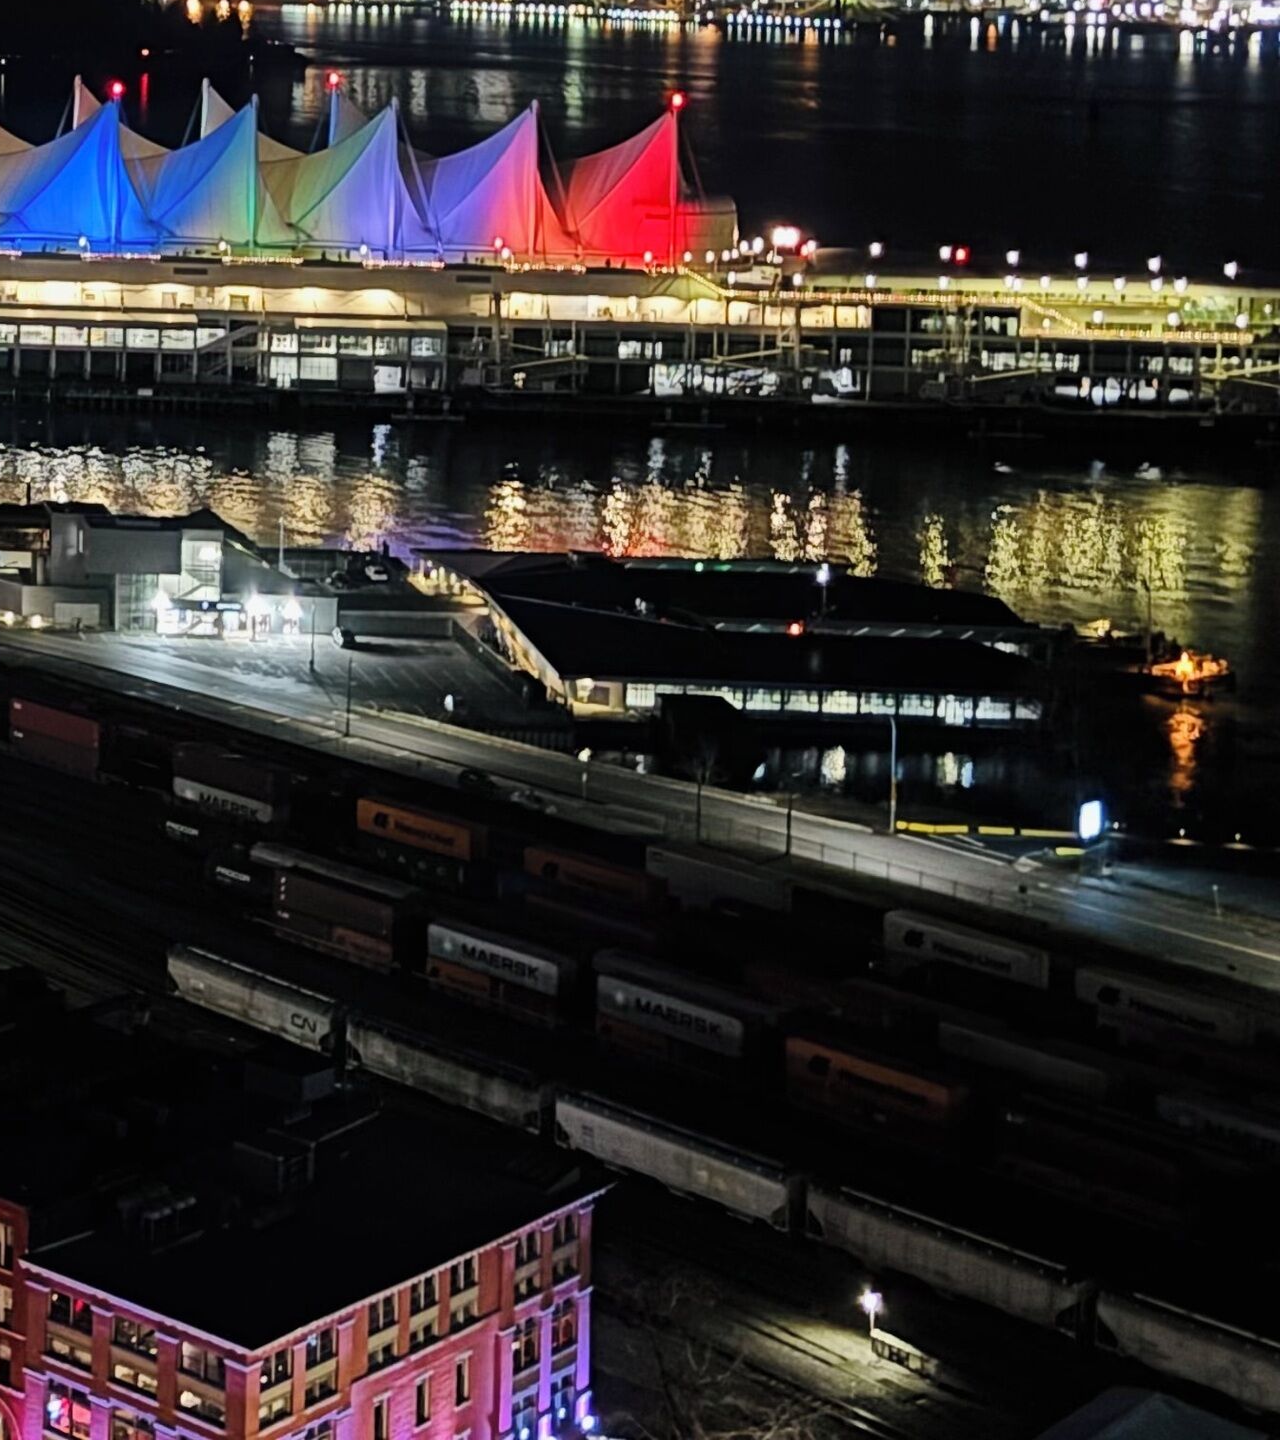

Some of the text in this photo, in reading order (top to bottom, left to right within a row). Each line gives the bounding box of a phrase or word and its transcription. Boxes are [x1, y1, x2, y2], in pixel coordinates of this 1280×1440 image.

[461, 943, 539, 980] MAERSK
[291, 1012, 317, 1033] CN
[635, 998, 721, 1040] MAERSK
